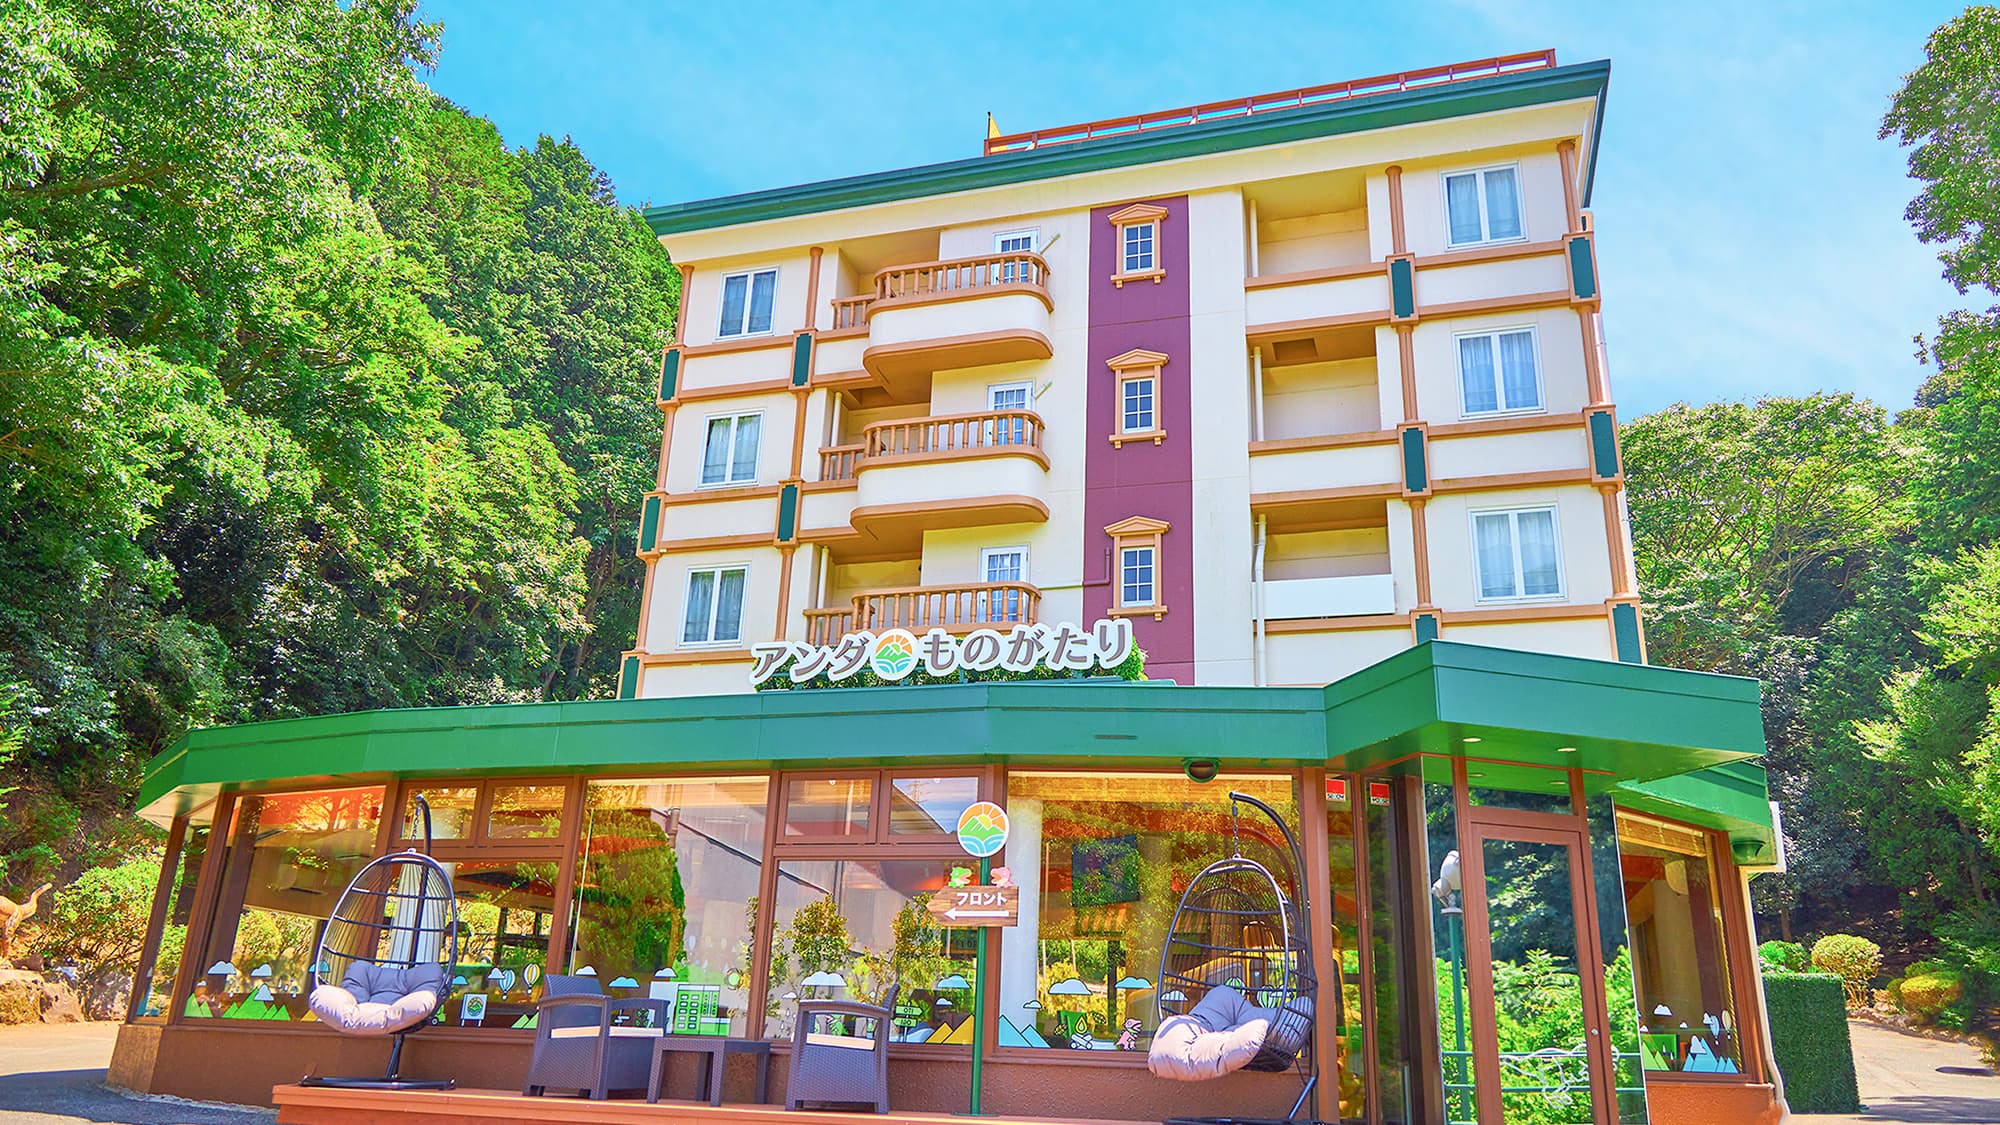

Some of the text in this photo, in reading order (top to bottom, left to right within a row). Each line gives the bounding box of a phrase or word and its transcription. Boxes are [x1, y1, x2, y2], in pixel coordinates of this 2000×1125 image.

[753, 624, 1127, 678] アンダ ものがたり
[956, 892, 1007, 906] フロント
